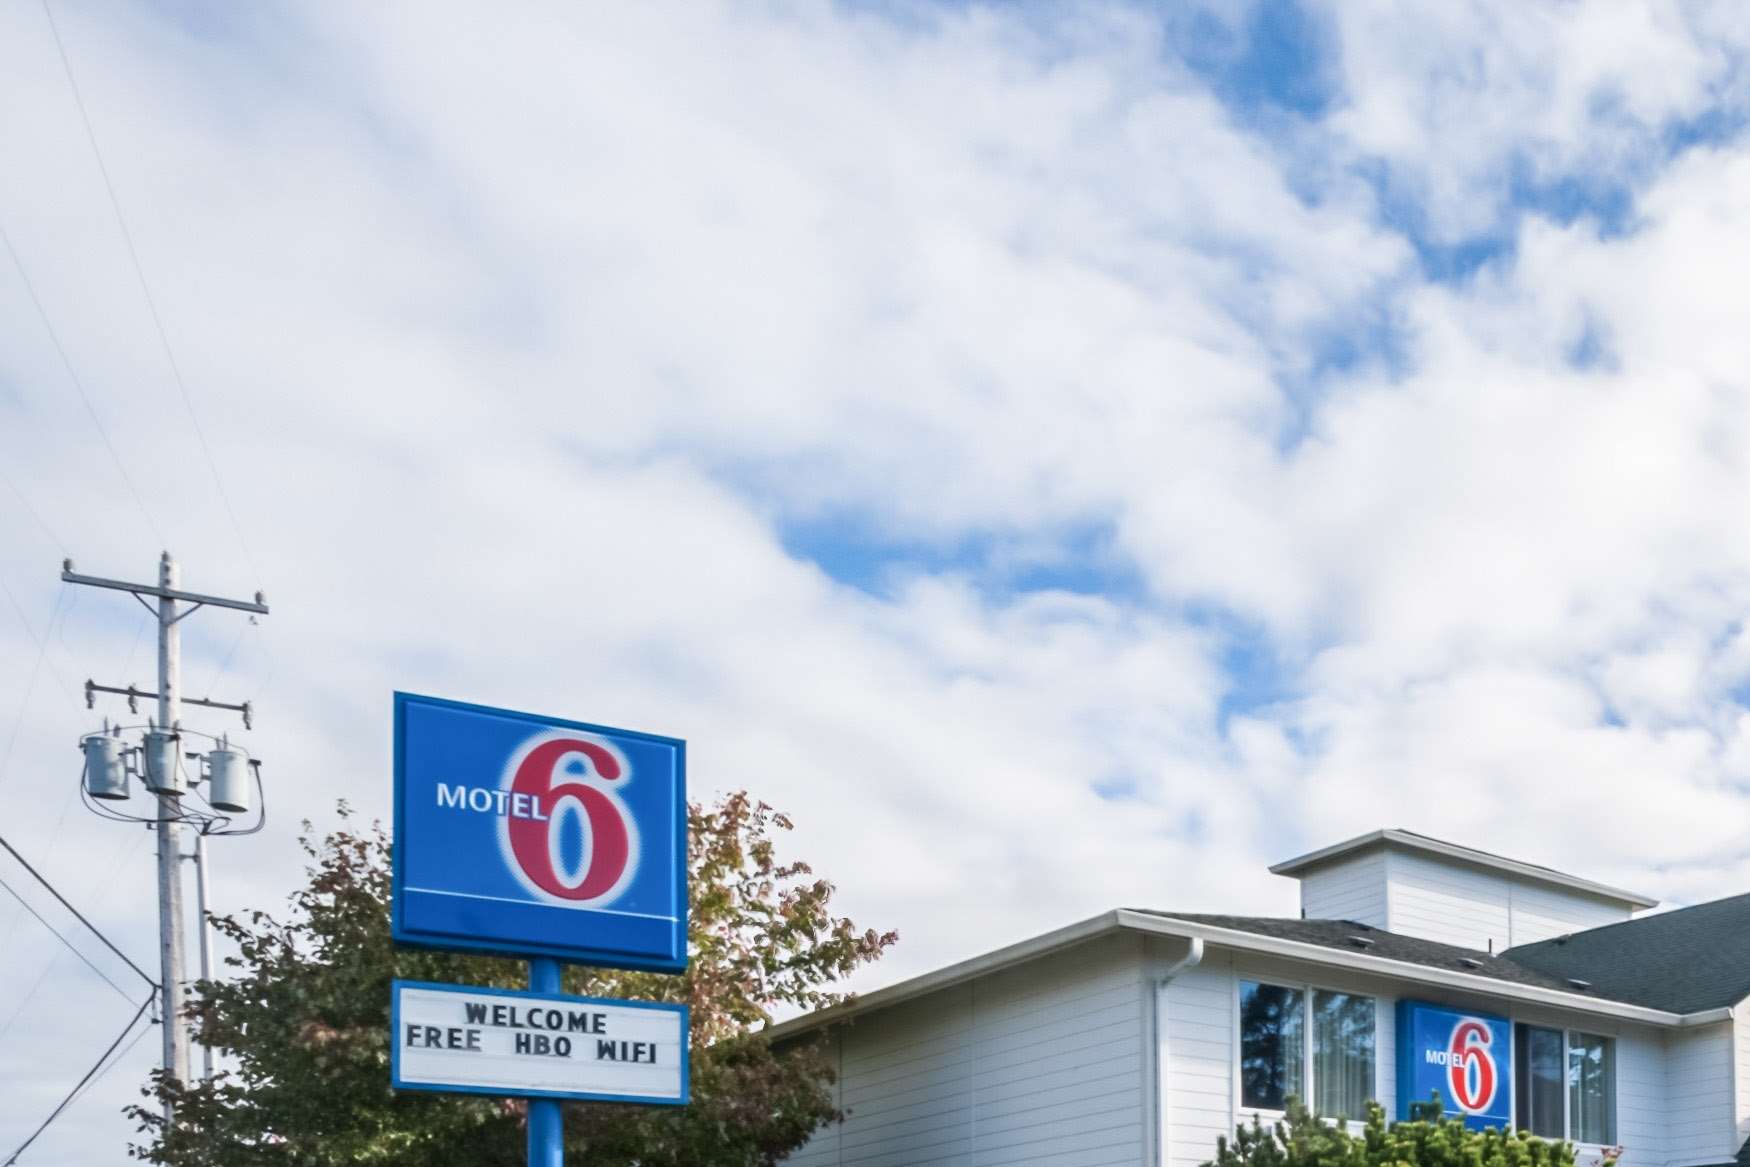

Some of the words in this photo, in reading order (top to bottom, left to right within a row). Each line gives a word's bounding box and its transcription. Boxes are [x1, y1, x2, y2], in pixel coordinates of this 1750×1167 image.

[436, 782, 550, 822] MOTEL
[505, 734, 633, 904] 6
[406, 1024, 482, 1051] FREE
[514, 1032, 572, 1058] HBO
[596, 1039, 657, 1064] WIFI
[465, 1002, 608, 1035] WELCOME
[1425, 1049, 1467, 1069] MOTEL
[1449, 1020, 1495, 1112] 6
